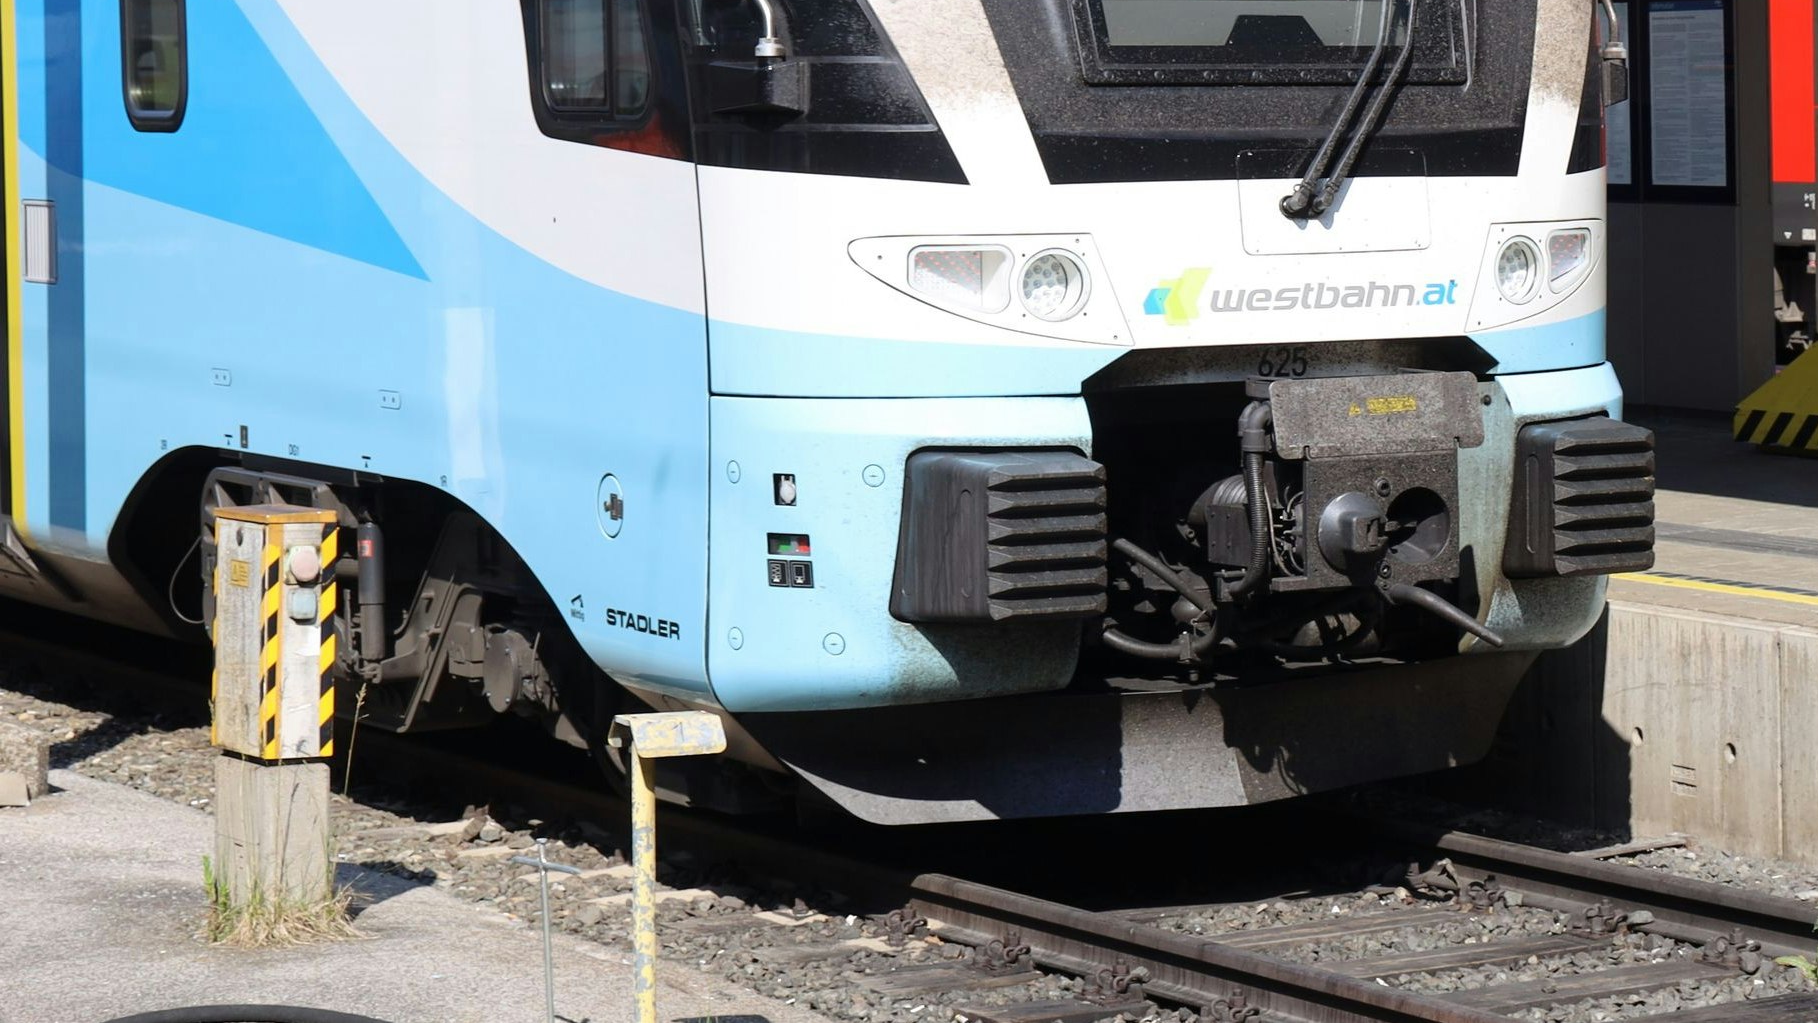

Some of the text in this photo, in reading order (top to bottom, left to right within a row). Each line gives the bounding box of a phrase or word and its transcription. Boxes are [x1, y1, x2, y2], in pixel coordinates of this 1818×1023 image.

[1210, 279, 1458, 313] westbahn.at
[1258, 347, 1308, 377] 625
[606, 608, 681, 640] STADLER
